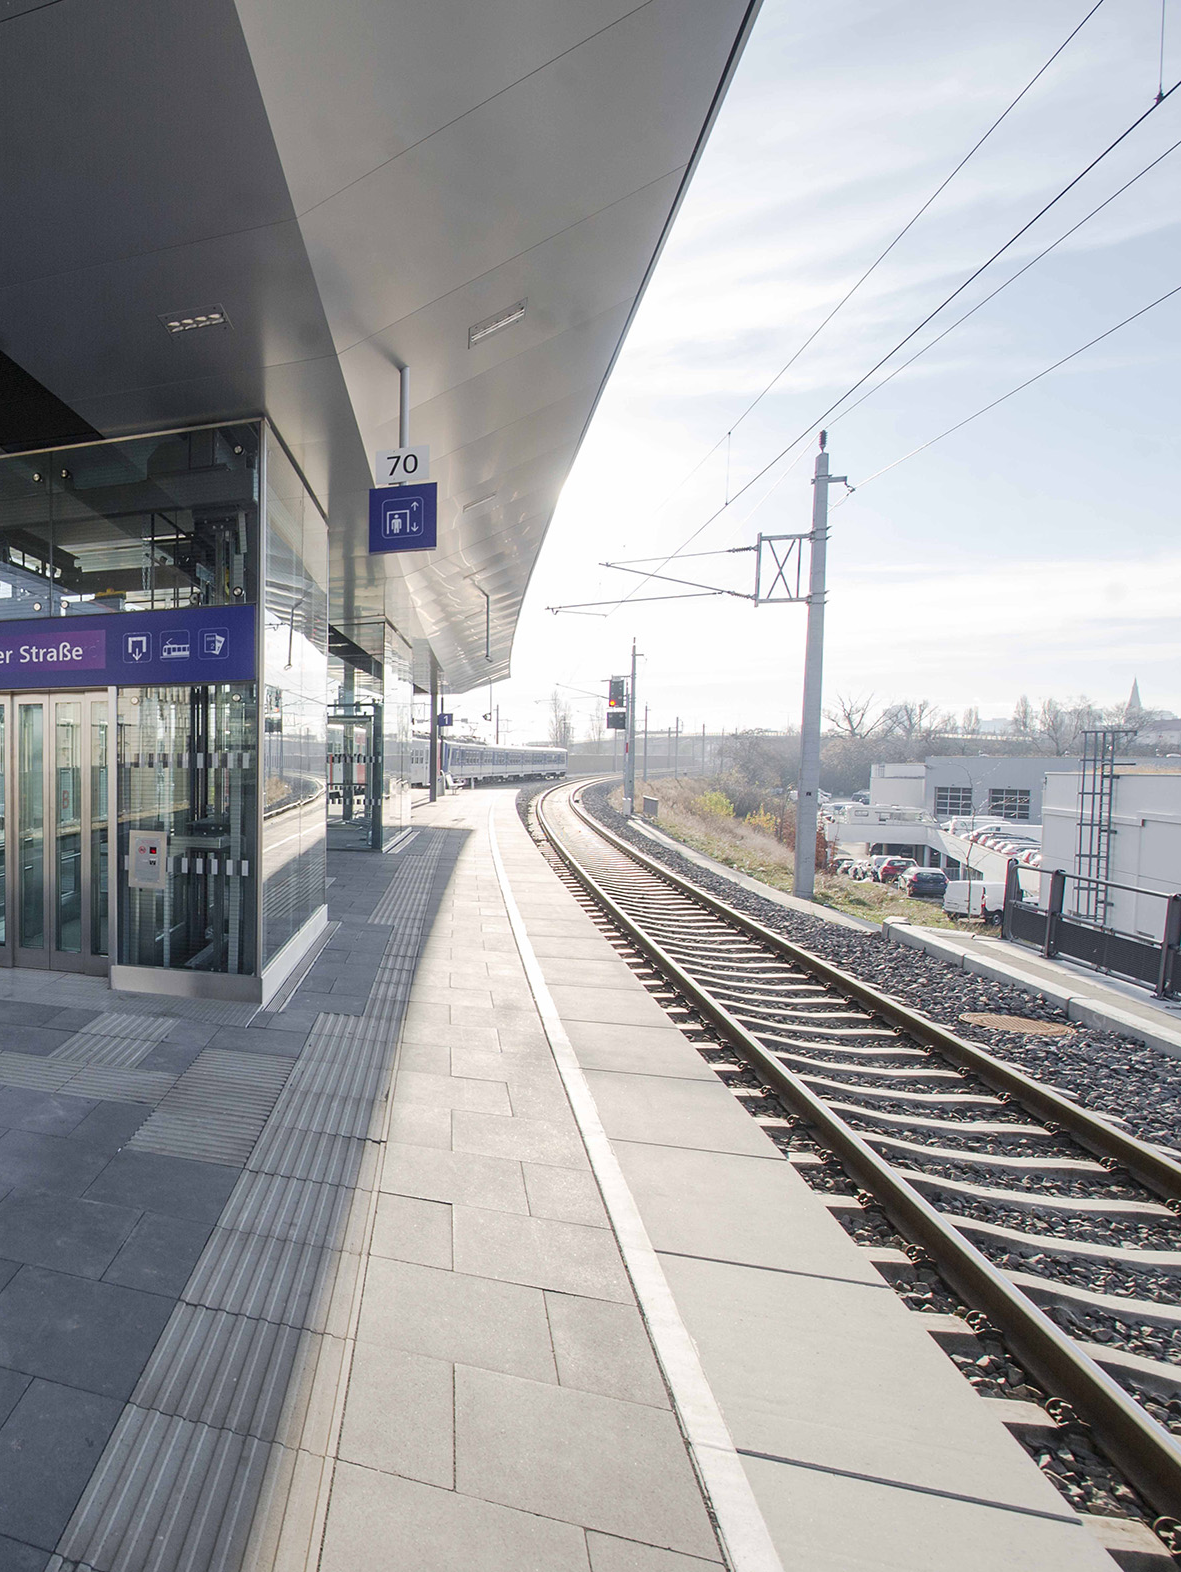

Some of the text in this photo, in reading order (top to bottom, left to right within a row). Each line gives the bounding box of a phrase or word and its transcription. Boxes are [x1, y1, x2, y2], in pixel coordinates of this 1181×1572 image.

[386, 453, 419, 477] 70
[19, 641, 84, 664] Straße
[443, 715, 449, 725] 1
